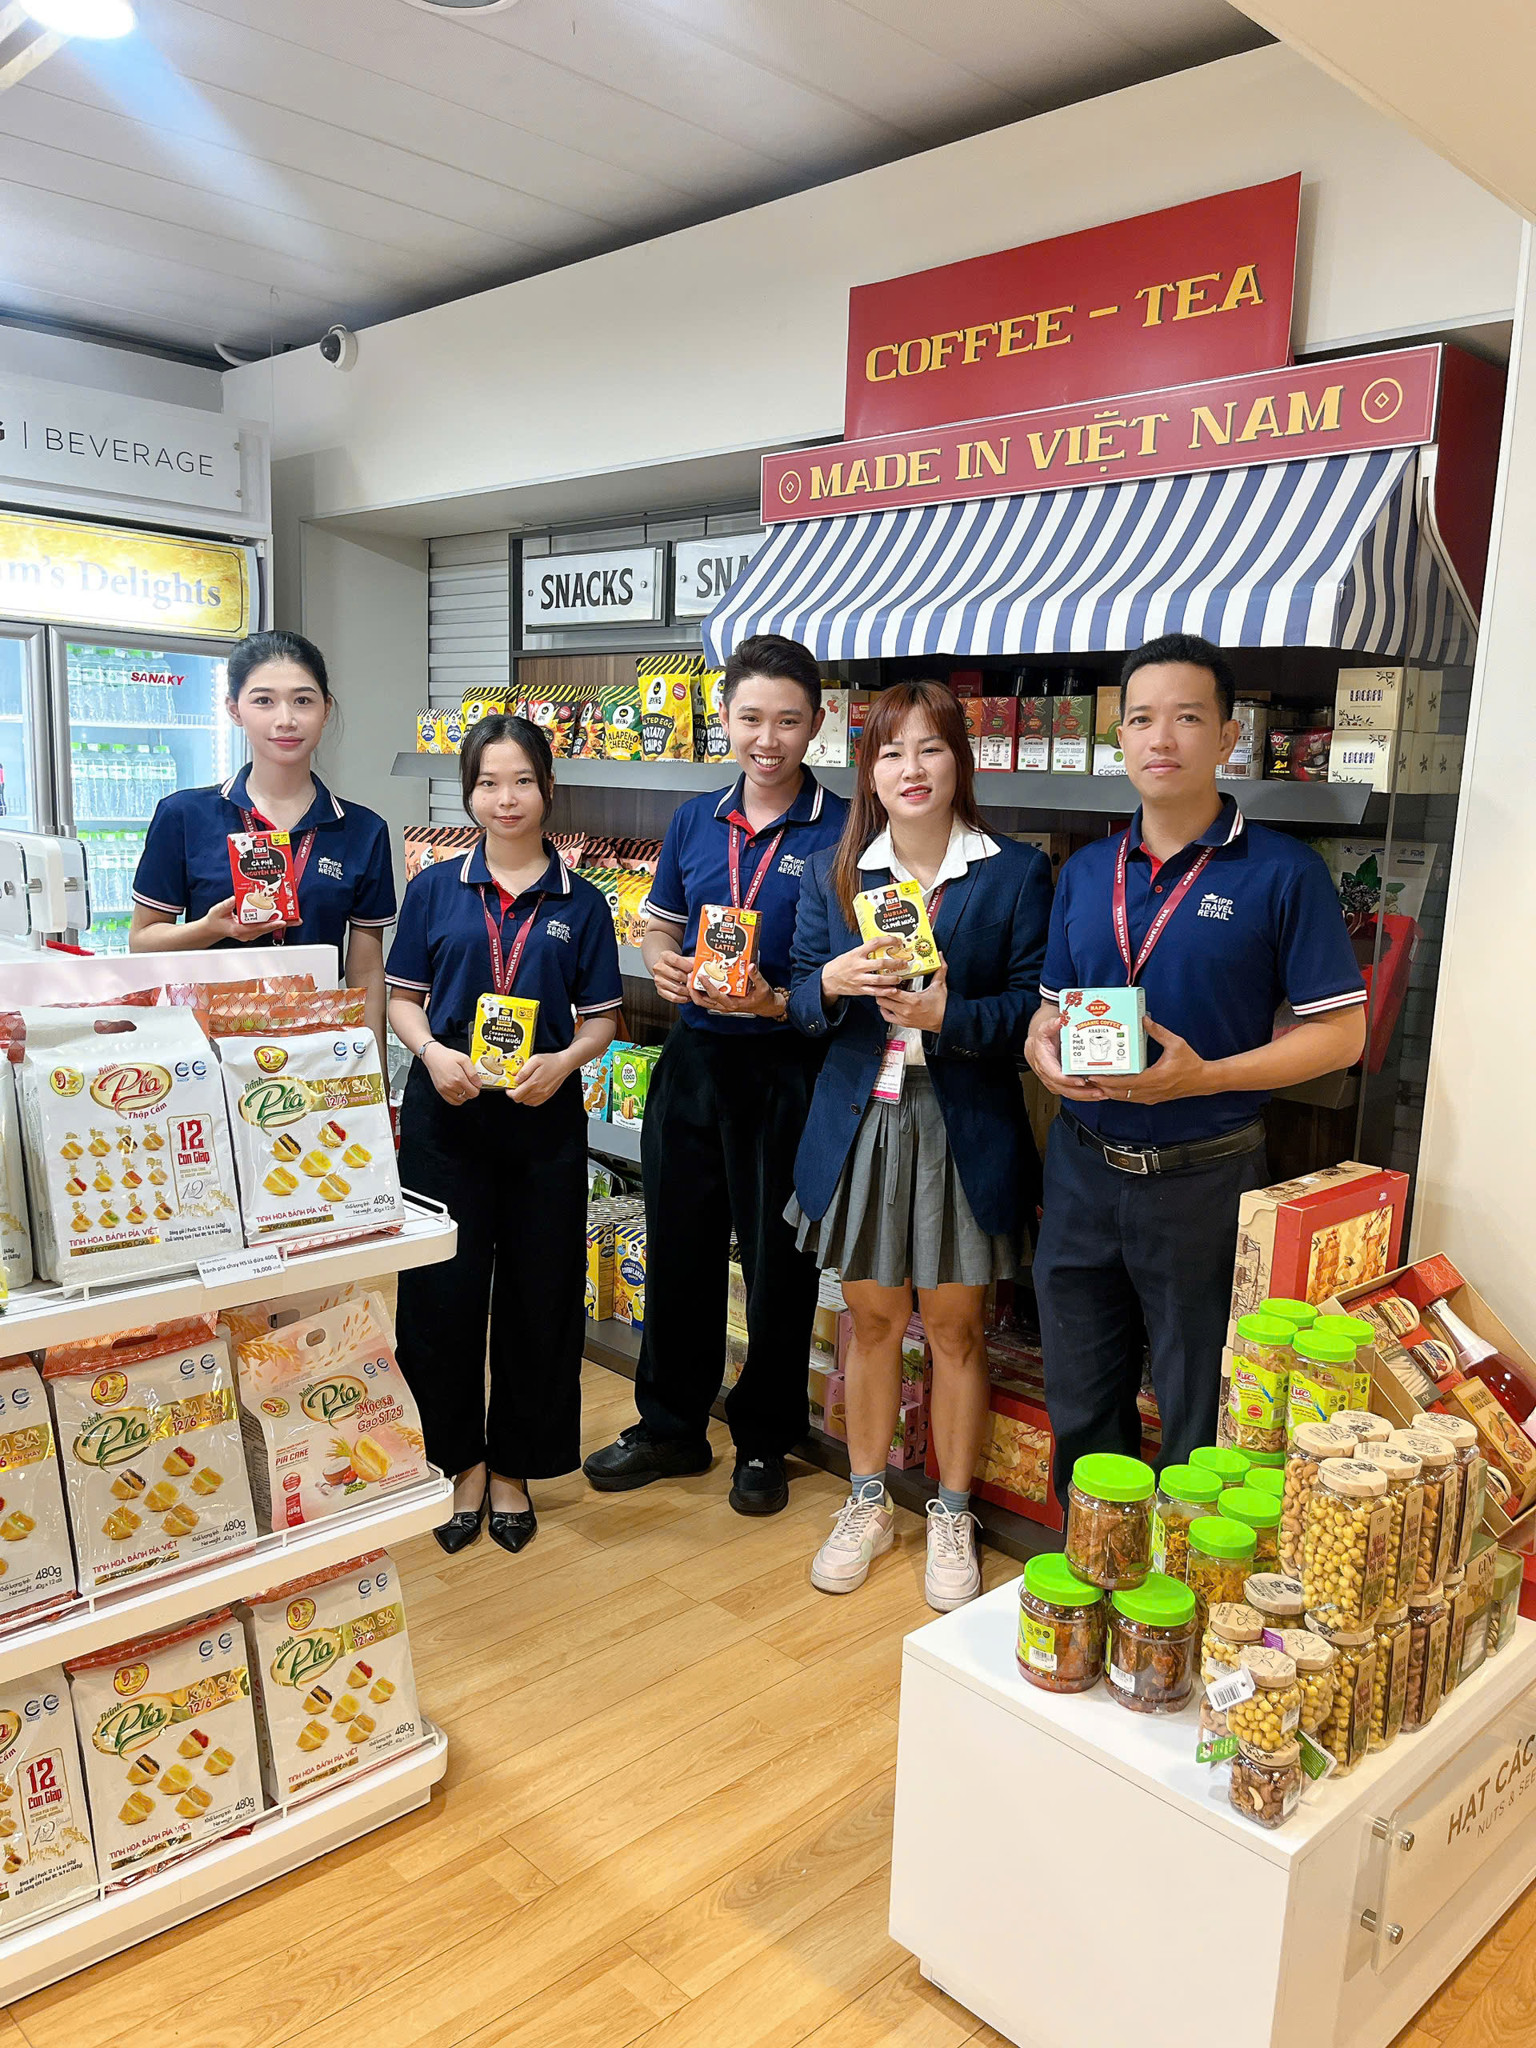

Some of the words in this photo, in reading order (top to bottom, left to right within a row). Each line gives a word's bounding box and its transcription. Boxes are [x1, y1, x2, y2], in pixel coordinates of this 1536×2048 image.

[865, 305, 1076, 382] COFFEE
[1134, 263, 1265, 329] TEA
[808, 448, 942, 500] MADE
[954, 437, 1013, 482] IN
[1026, 409, 1170, 475] VIỆT
[1186, 384, 1346, 449] NAM
[45, 427, 214, 477] BEVERAGE
[77, 560, 222, 612] Delights
[540, 567, 634, 611] SNACKS
[131, 671, 187, 687] SANAKY
[642, 726, 666, 740] POTATO
[610, 738, 634, 751] CHEESE
[643, 740, 663, 753] CHIPS
[319, 863, 343, 875] TRAVEL
[780, 861, 804, 873] TRAVEL
[1192, 852, 1208, 871] TRAVEL
[318, 868, 342, 880] RETAIL
[778, 866, 802, 877] RETAIL
[1200, 902, 1234, 915] TRAVEL
[1217, 897, 1234, 906] IPP
[883, 908, 909, 918] DURIAN
[1197, 909, 1230, 921] RETAIL
[547, 926, 571, 939] TRAVEL
[1118, 925, 1126, 948] TRAVEL
[1145, 926, 1159, 949] TRAVEL
[1155, 908, 1170, 929] RETAIL
[714, 944, 735, 952] LATTE
[507, 959, 517, 976] TRAVEL
[491, 1025, 516, 1034] BANANA
[1076, 1019, 1100, 1030] ORGANIC
[1100, 1019, 1121, 1030] COFFEE
[98, 1067, 164, 1110] Pía
[324, 1082, 351, 1096] KIM
[351, 1080, 373, 1094] SA
[244, 1083, 306, 1122] Pía
[325, 1096, 348, 1108] 12/6
[128, 1111, 150, 1120] Thập
[177, 1119, 205, 1151] 12
[178, 1153, 193, 1166] Con
[181, 1179, 204, 1200] 12
[373, 1194, 395, 1207] 480g
[256, 1214, 272, 1223] TINH
[272, 1212, 287, 1221] HOA
[287, 1209, 306, 1219] BÁNH
[306, 1207, 318, 1216] PÍA
[318, 1204, 332, 1214] VIỆT
[69, 1238, 87, 1248] TINH
[87, 1236, 106, 1244] HOA
[105, 1231, 124, 1241] BÁNH
[125, 1228, 141, 1239] PÍA
[80, 1242, 120, 1255] Vietnamese
[134, 1238, 150, 1247] Cake
[202, 1267, 217, 1275] Bánh
[227, 1262, 240, 1272] chay
[170, 1403, 200, 1420] KIM
[204, 1396, 224, 1411] SA
[308, 1383, 361, 1424] Pía
[378, 1405, 404, 1424] ST25
[172, 1417, 197, 1432] 12/6
[14, 1430, 40, 1450] SA
[82, 1416, 150, 1466] Pía
[9, 1455, 23, 1464] TAN
[275, 1454, 289, 1466] PIA
[289, 1448, 309, 1461] CAKE
[222, 1518, 246, 1533] 480g
[92, 1563, 109, 1574] TINH
[110, 1558, 126, 1569] HOA
[127, 1550, 148, 1562] BÁNH
[148, 1546, 161, 1556] PÍA
[161, 1540, 178, 1551] VIỆT
[34, 1565, 62, 1581] 480g
[351, 1619, 376, 1635] KIM
[377, 1608, 397, 1627] SA
[275, 1636, 295, 1654] Bánh
[277, 1637, 335, 1683] Pía
[186, 1682, 214, 1701] KIM
[217, 1674, 238, 1689] SA
[100, 1702, 123, 1722] Bánh
[188, 1698, 213, 1715] 12/6
[101, 1703, 165, 1755] Pía
[394, 1722, 415, 1736] 480g
[288, 1773, 302, 1783] TINH
[302, 1767, 315, 1777] HOA
[316, 1759, 333, 1771] BÁNH
[333, 1754, 344, 1763] PÍA
[345, 1747, 359, 1757] VIỆT
[25, 1757, 57, 1794] 12
[1446, 1777, 1491, 1845] HẠT
[1494, 1733, 1536, 1794] CÁC
[28, 1794, 44, 1810] Con
[234, 1797, 255, 1811] 480g
[1476, 1803, 1506, 1839] NUTS
[1507, 1791, 1515, 1807] &
[31, 1820, 56, 1846] 12
[110, 1848, 126, 1859] TINH
[126, 1842, 141, 1853] HOA
[141, 1833, 161, 1847] BÁNH
[162, 1828, 173, 1838] PÍA
